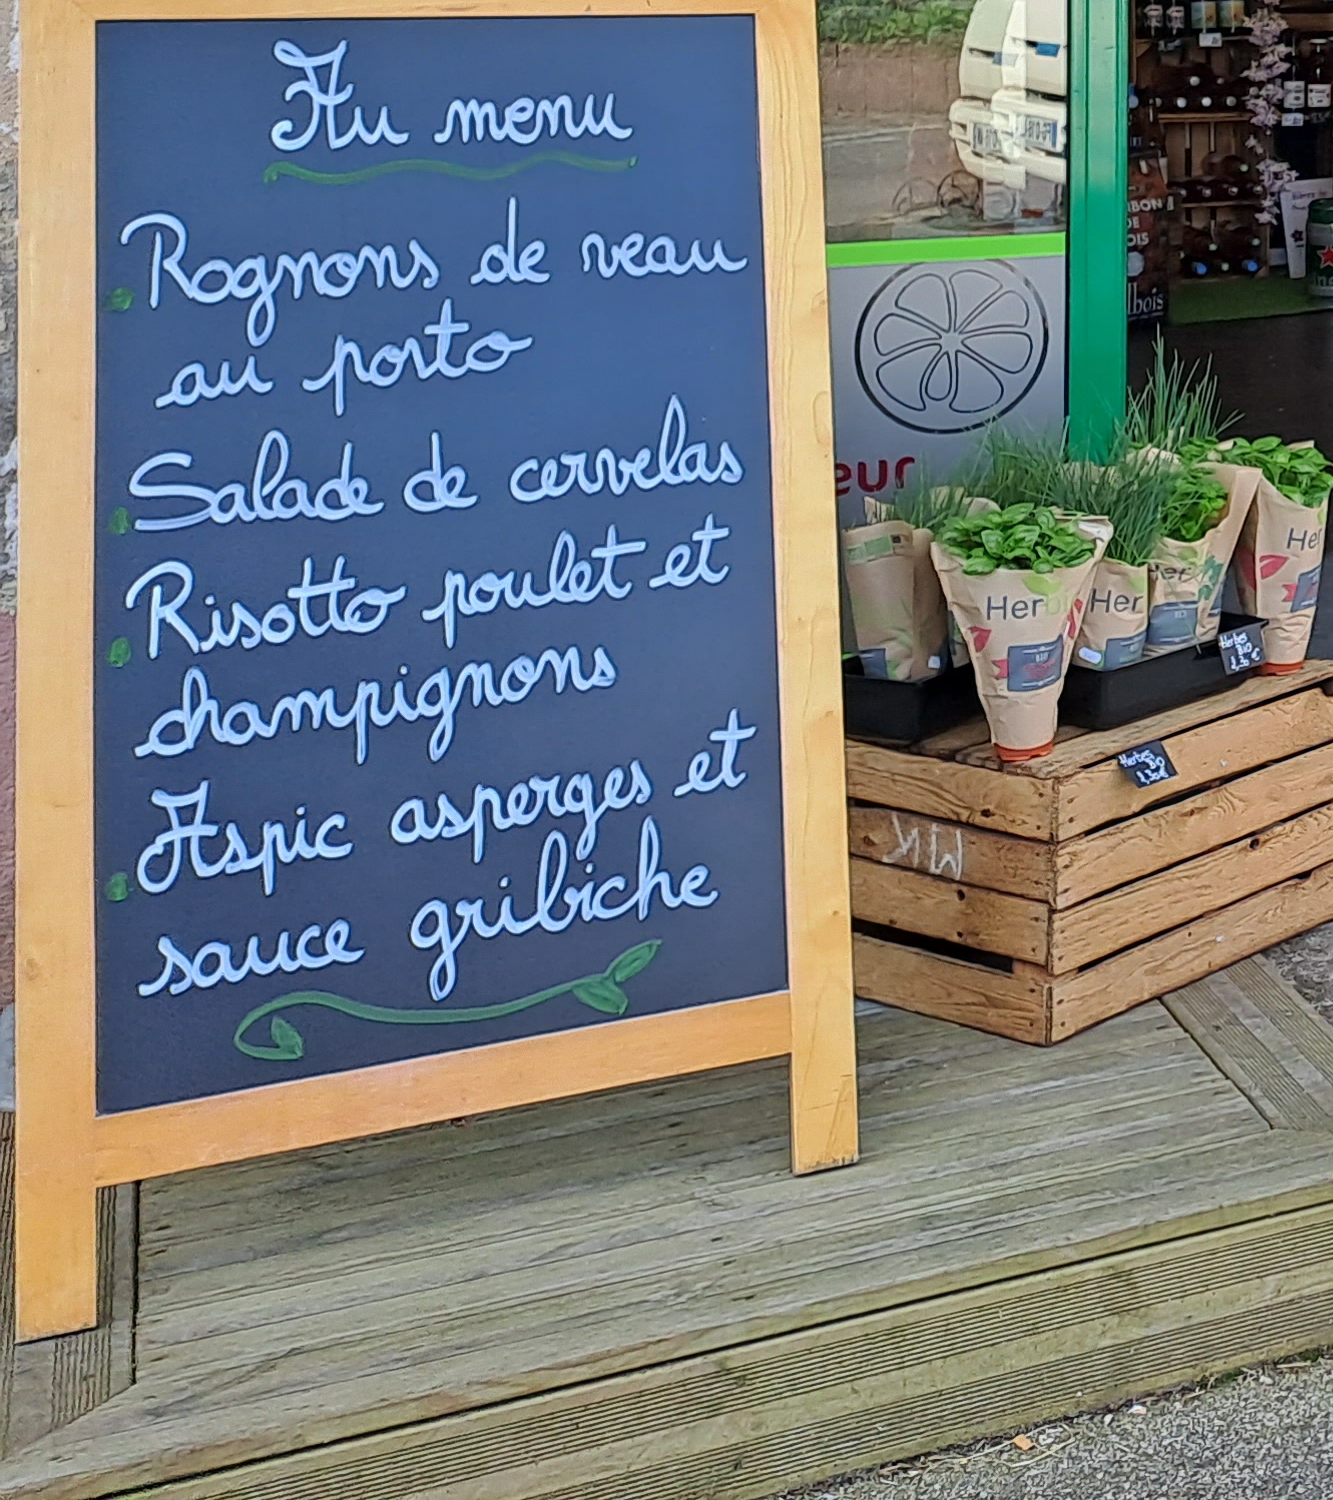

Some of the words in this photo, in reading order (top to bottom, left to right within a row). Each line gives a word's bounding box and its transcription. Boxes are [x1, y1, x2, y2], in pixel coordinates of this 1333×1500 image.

[271, 38, 408, 152] Au
[434, 92, 633, 146] menu
[121, 213, 441, 347] Rognons
[471, 197, 551, 288] de
[582, 230, 747, 276] veau
[155, 353, 274, 408] au
[302, 301, 532, 417] porto
[128, 431, 385, 532] Salade
[404, 432, 479, 510] de
[509, 394, 744, 506] cervelas
[125, 555, 407, 660] Risotto
[423, 528, 646, 647] poulet
[649, 514, 730, 590] et
[134, 645, 618, 764] champignons
[137, 780, 352, 896] Aspic
[391, 759, 653, 862] asperges
[674, 708, 756, 799] et
[138, 919, 364, 998] sauce
[409, 816, 719, 1002] gribiche
